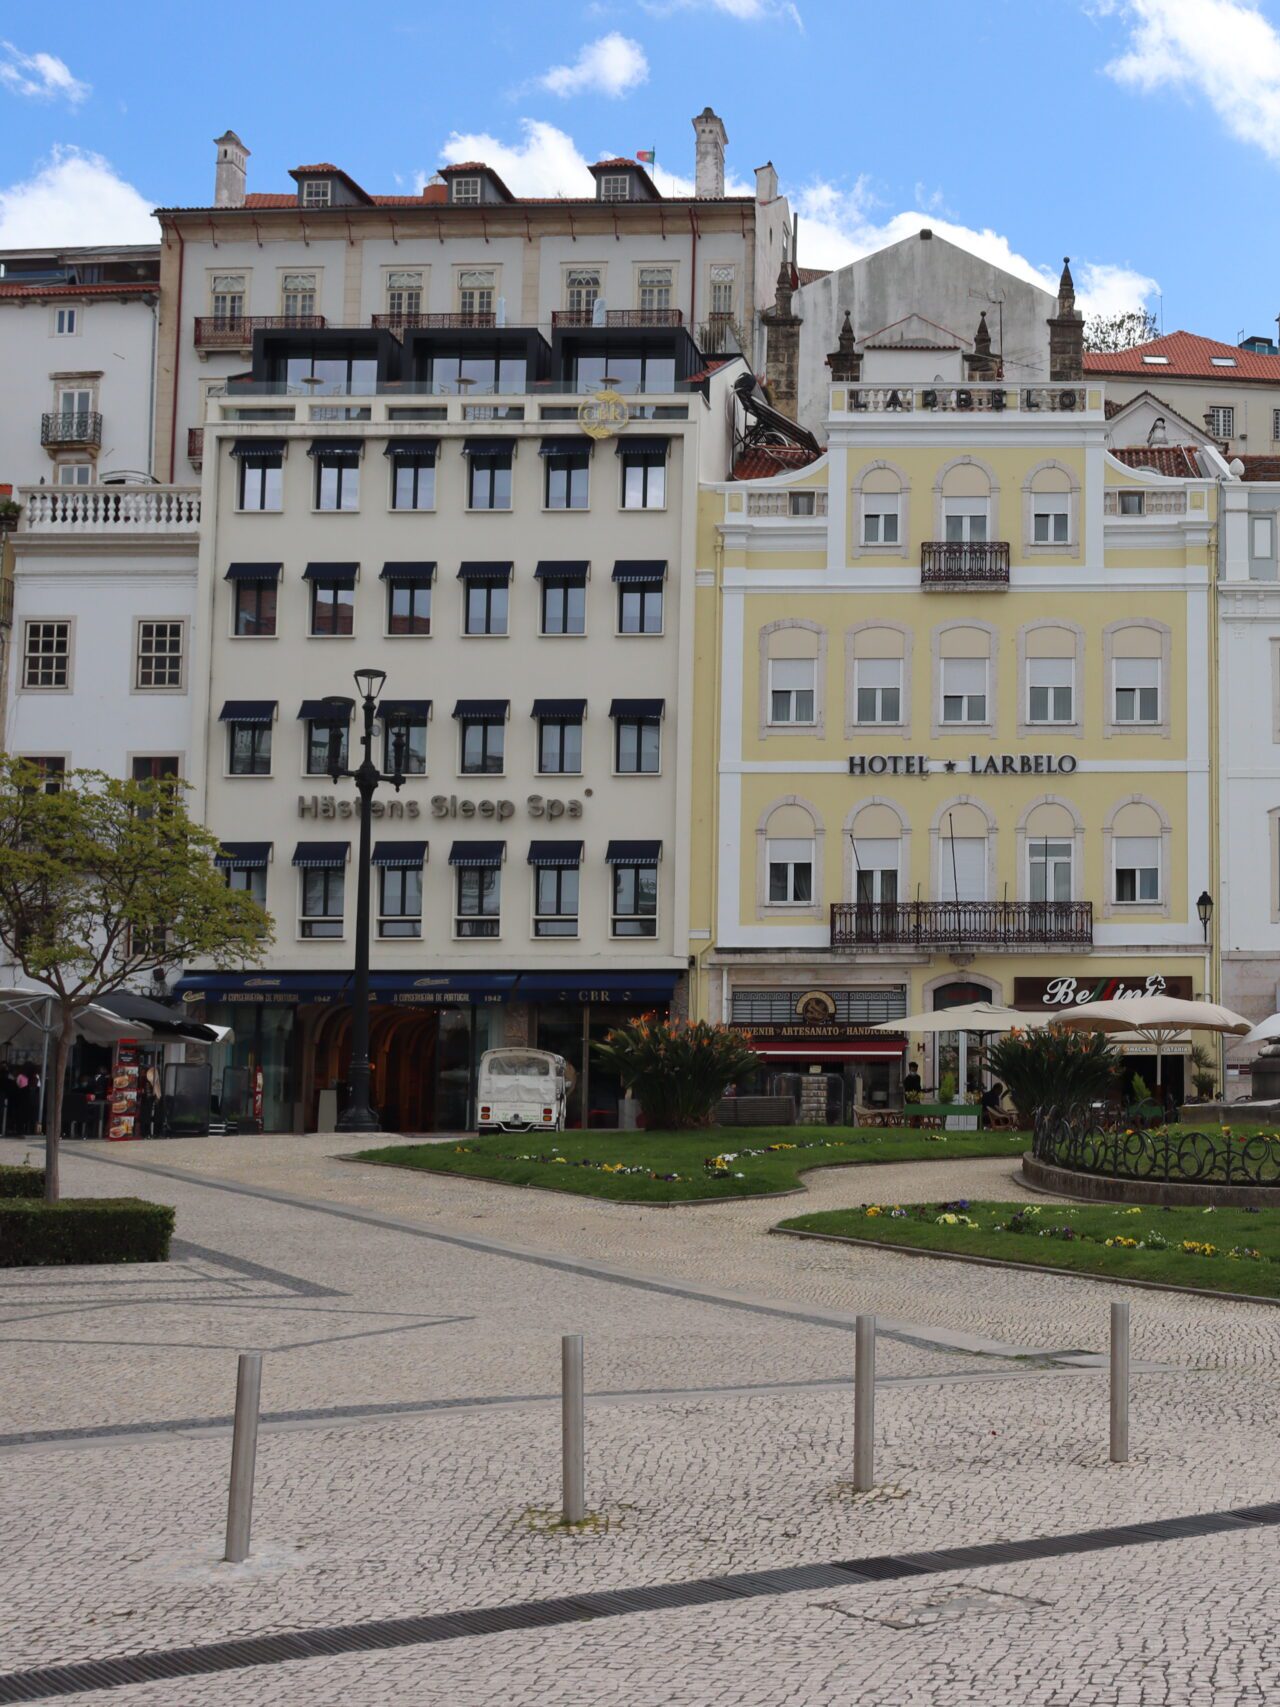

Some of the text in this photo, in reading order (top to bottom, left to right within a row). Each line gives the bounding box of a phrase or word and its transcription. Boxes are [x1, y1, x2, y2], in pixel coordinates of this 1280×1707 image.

[853, 389, 1076, 408] LARBELO
[848, 754, 1077, 775] HOTEL LARBELO
[430, 795, 516, 822] Sleep
[526, 794, 583, 822] Spa
[578, 990, 610, 1001] CBR
[781, 1027, 839, 1036] ARTESANATO
[917, 1042, 925, 1052] H
